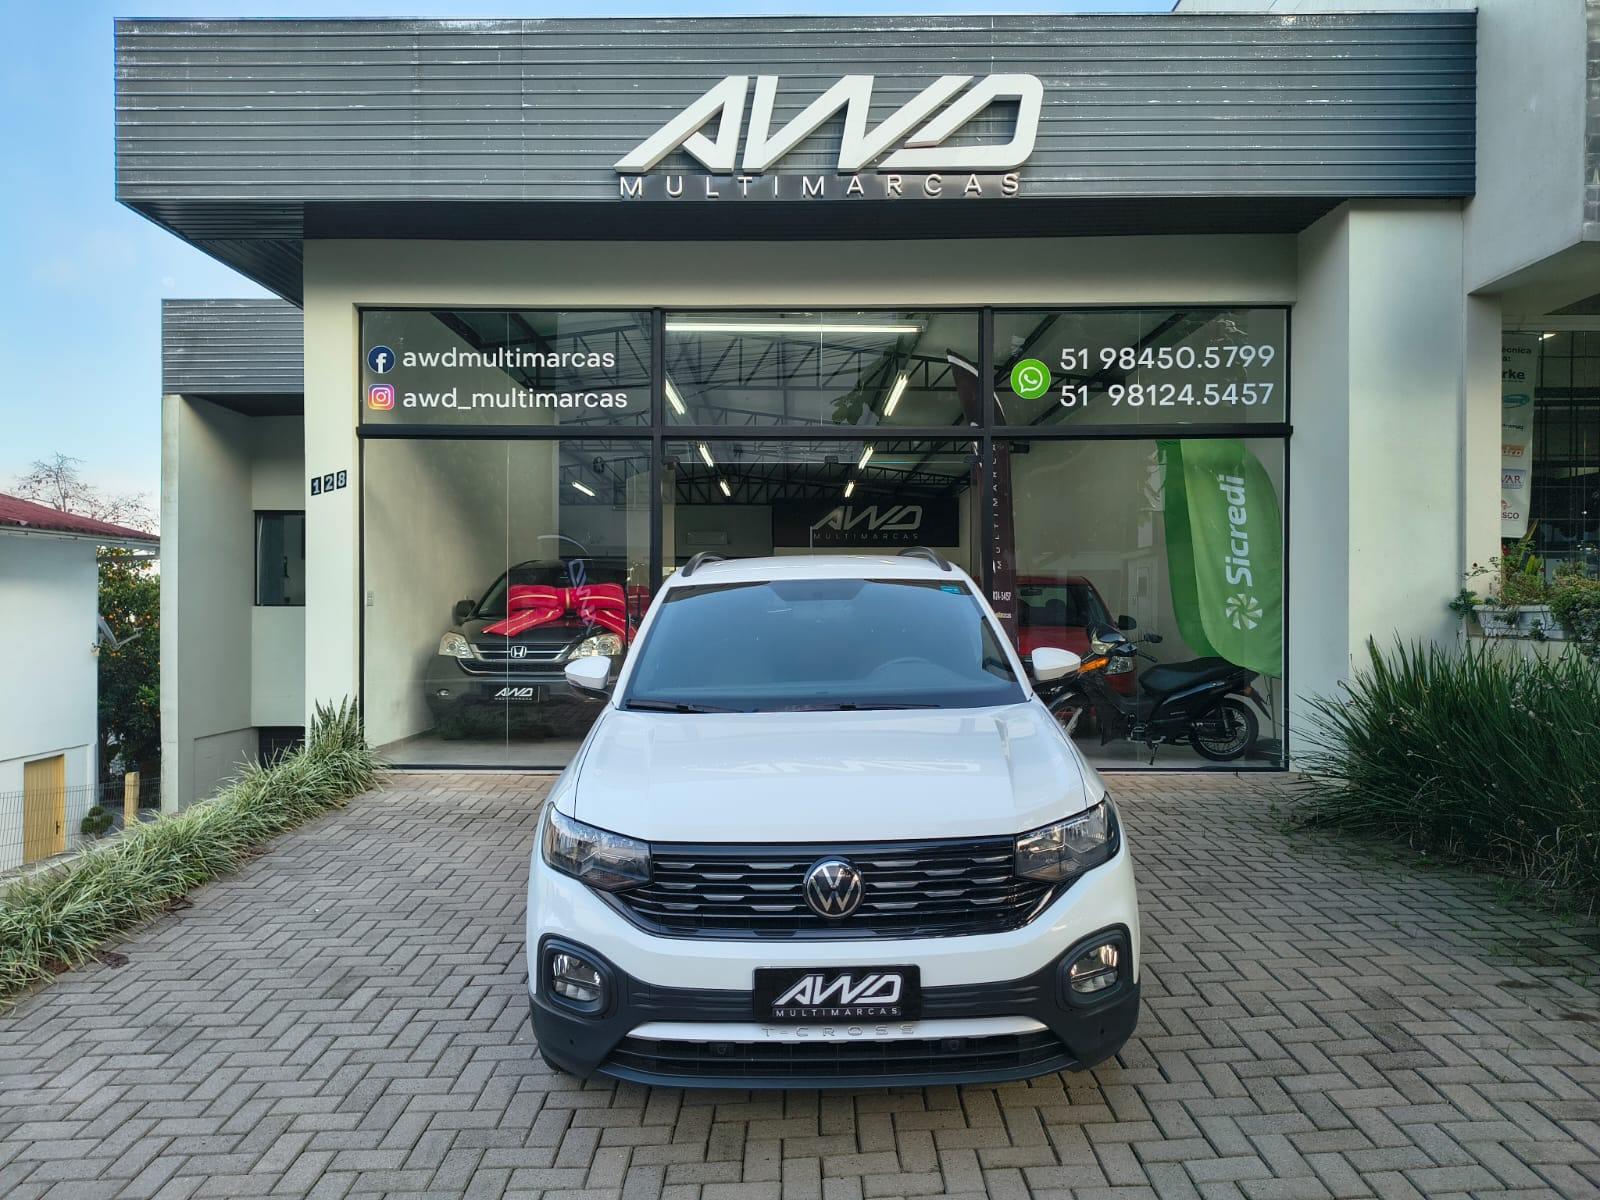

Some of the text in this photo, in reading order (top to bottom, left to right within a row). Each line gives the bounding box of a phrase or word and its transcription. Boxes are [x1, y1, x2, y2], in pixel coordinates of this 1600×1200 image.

[613, 74, 1044, 173] AWD
[619, 174, 1020, 199] MULTIMARCAS
[402, 347, 615, 368] awdmultimarcas
[1060, 345, 1275, 370] 51 98450.5799
[1502, 369, 1526, 380] rke
[402, 388, 628, 410] awd_multimarcas
[1060, 383, 1275, 407] 51 98124.5457
[312, 471, 346, 494] 128
[811, 506, 923, 530] AWD
[1502, 511, 1520, 520] SCO
[1219, 474, 1253, 587] Sicredi
[495, 687, 534, 697] AWD
[772, 973, 902, 1005] AWD
[775, 1007, 898, 1017] MULTIMARCAS
[762, 1024, 914, 1038] T-CROSS
